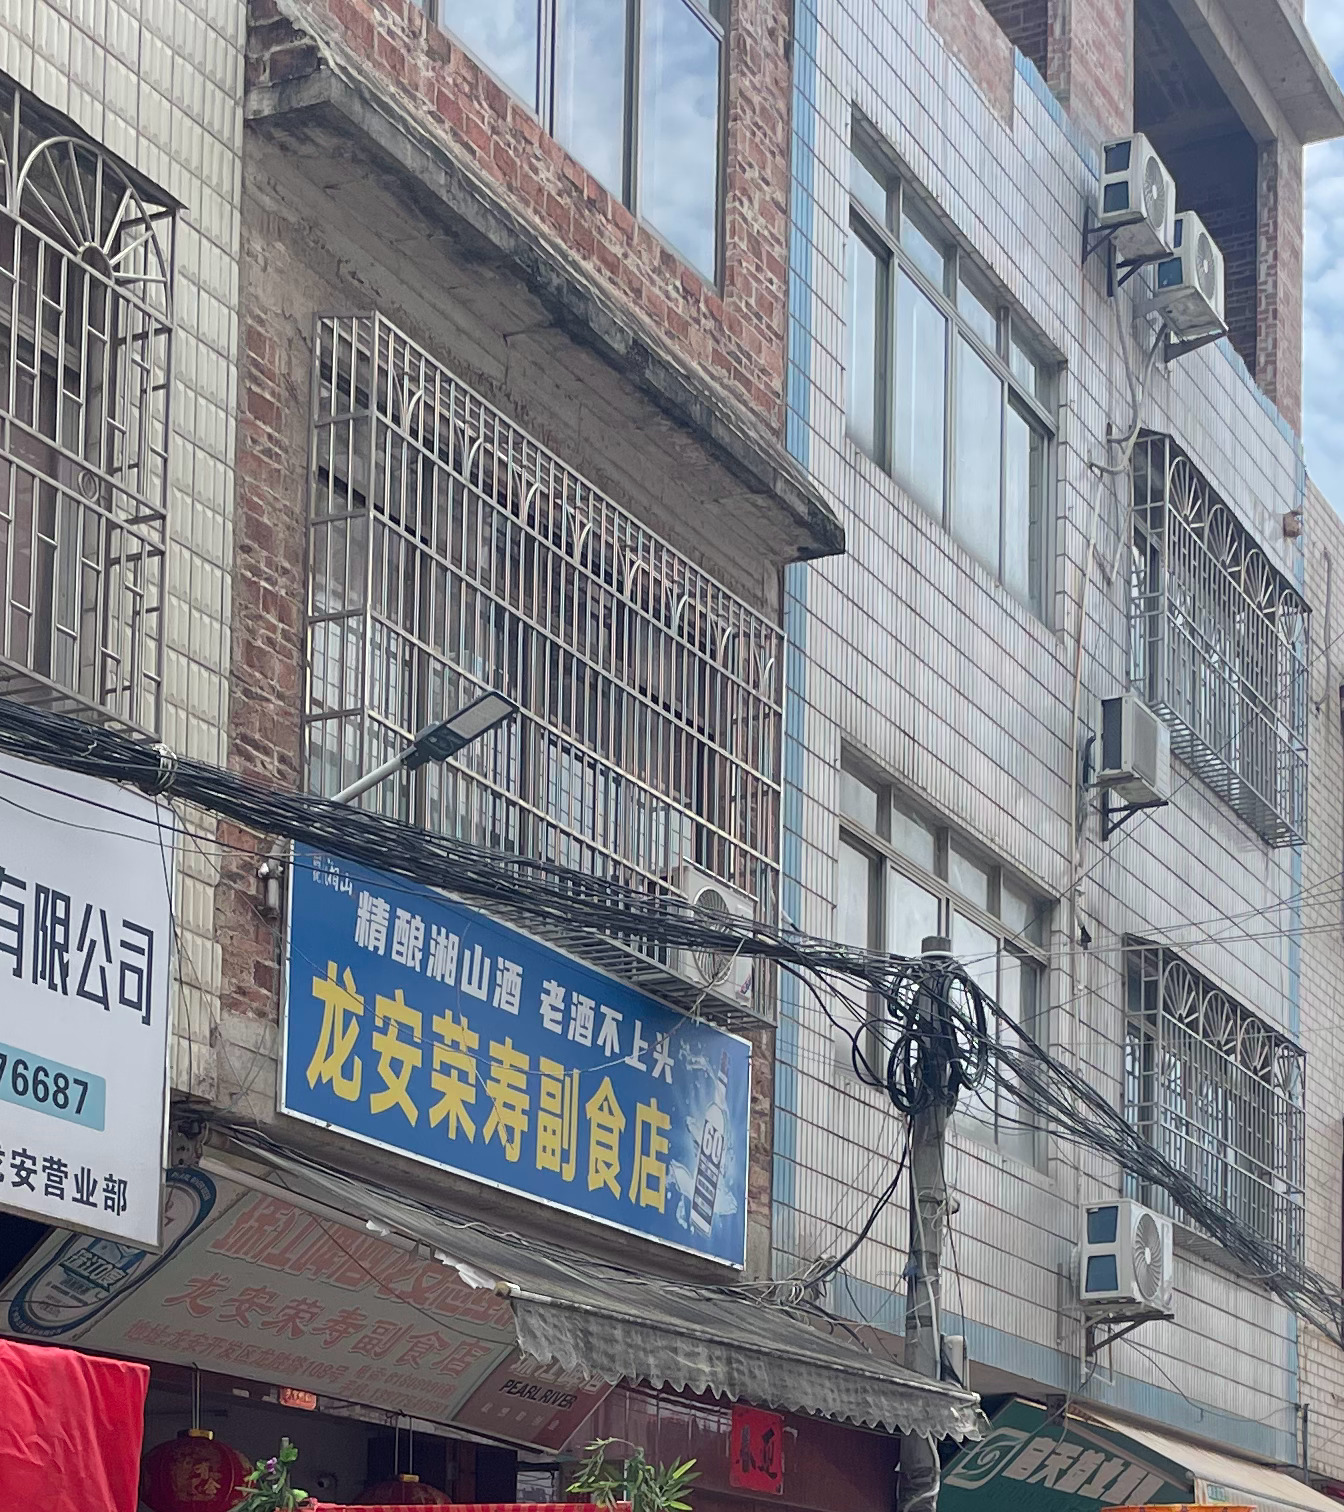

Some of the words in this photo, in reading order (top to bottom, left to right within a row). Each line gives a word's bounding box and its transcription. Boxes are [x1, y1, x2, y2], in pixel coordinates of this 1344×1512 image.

[354, 895, 524, 1016] 精酿湘山酒
[540, 979, 675, 1085] 老酒不上头
[306, 960, 673, 1216] 龙安荣寿副食店
[164, 1273, 492, 1380] 龙安荣寿副食店
[499, 1379, 539, 1401] PEARL
[539, 1390, 578, 1410] RIVER
